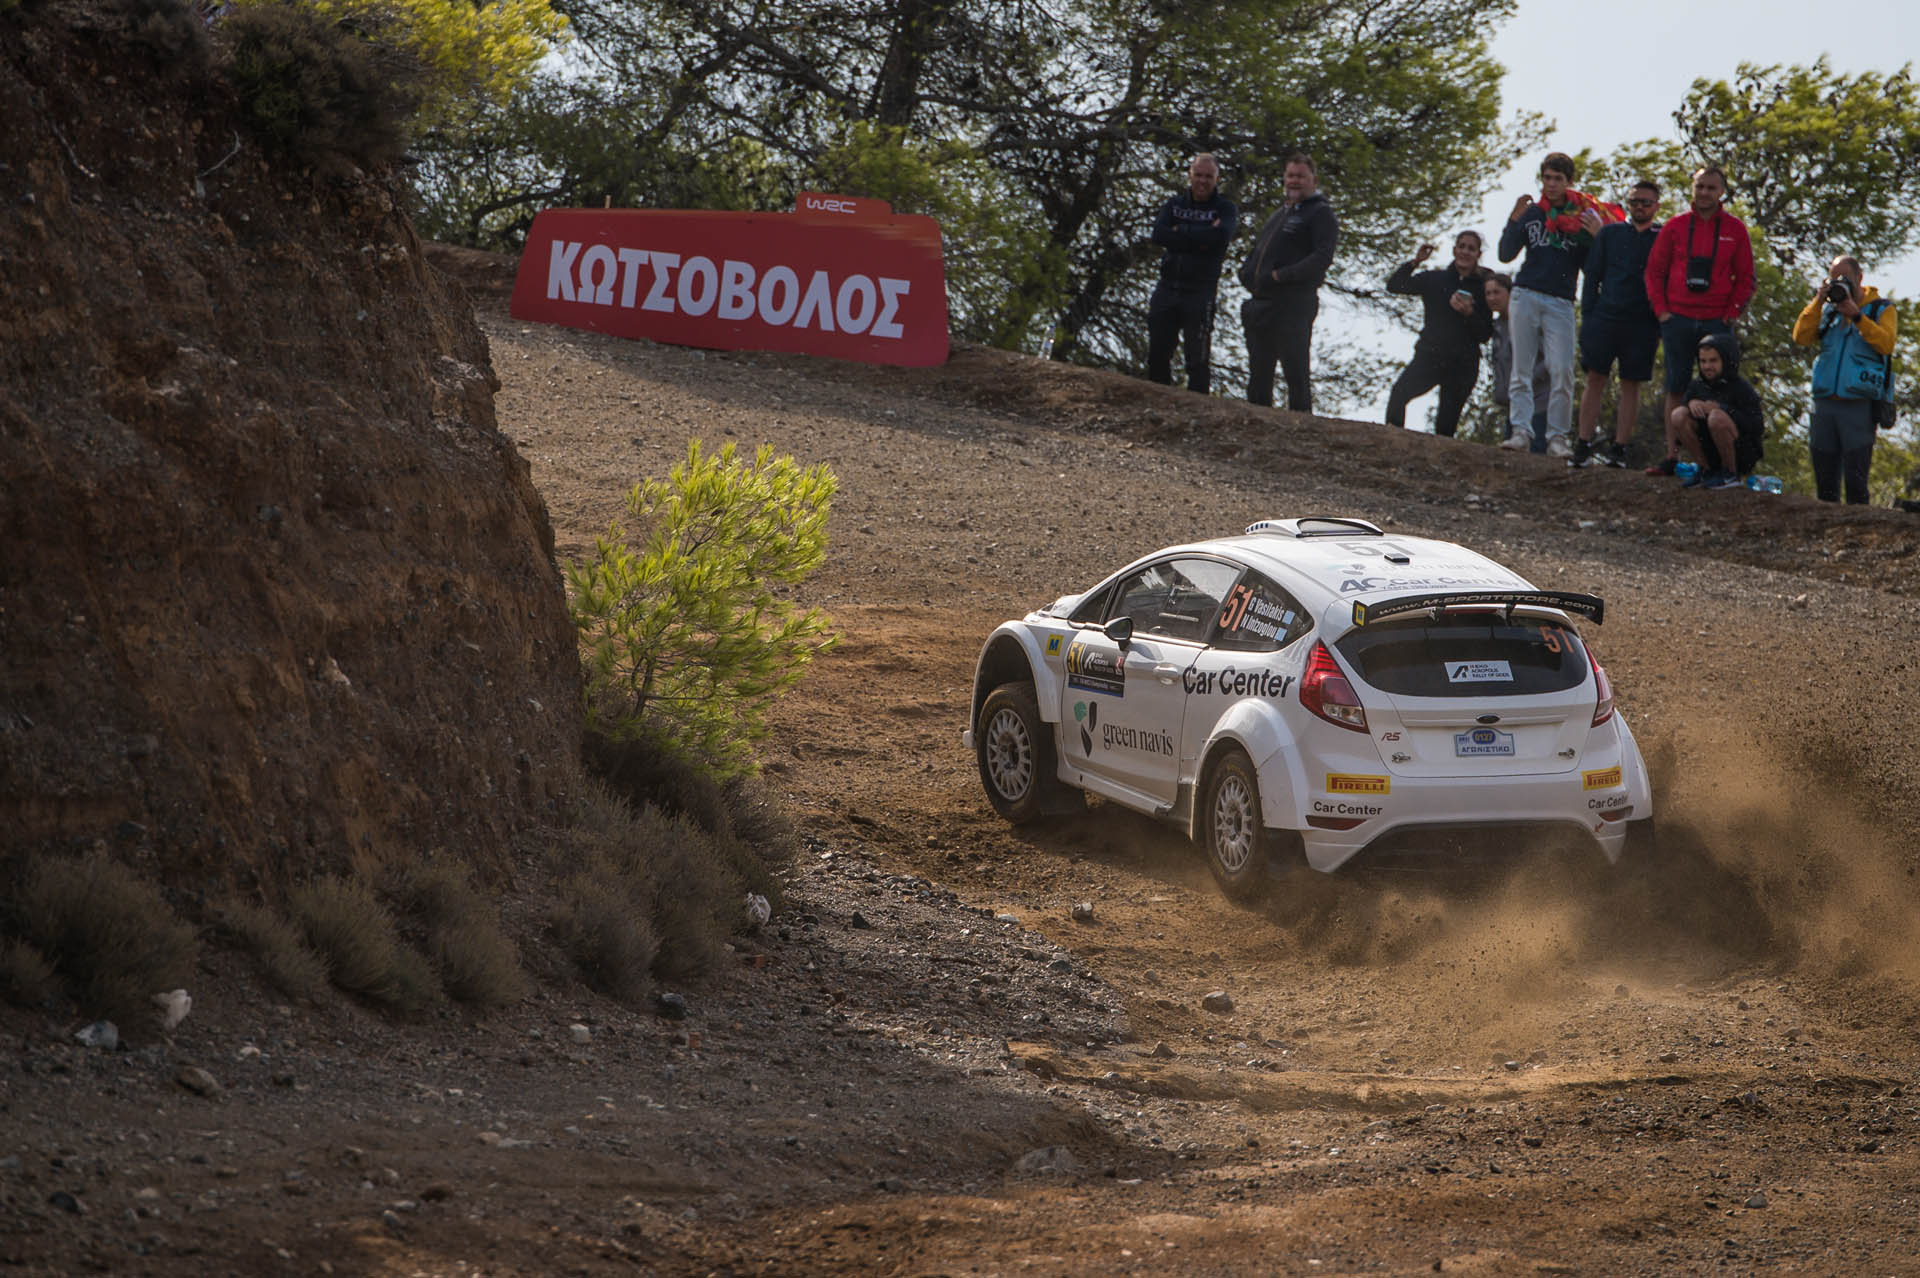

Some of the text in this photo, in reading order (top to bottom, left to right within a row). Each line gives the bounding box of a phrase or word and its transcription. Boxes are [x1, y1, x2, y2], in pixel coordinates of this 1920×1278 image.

[806, 197, 856, 214] WRC
[547, 239, 911, 339] ΚΩΤΣΟΒΟΛΟΣ
[1336, 542, 1415, 556] 51
[1438, 576, 1520, 588] Center
[1219, 583, 1254, 632] 51
[1248, 596, 1257, 611] G
[1539, 625, 1574, 653] 51
[1182, 664, 1296, 697] Car Center
[1103, 723, 1174, 756] green navis
[1381, 732, 1401, 741] RS
[1331, 777, 1385, 791] PIRELLI
[1586, 770, 1620, 786] PIRELLI
[1314, 801, 1383, 815] Car Center
[1588, 799, 1606, 809] Car
